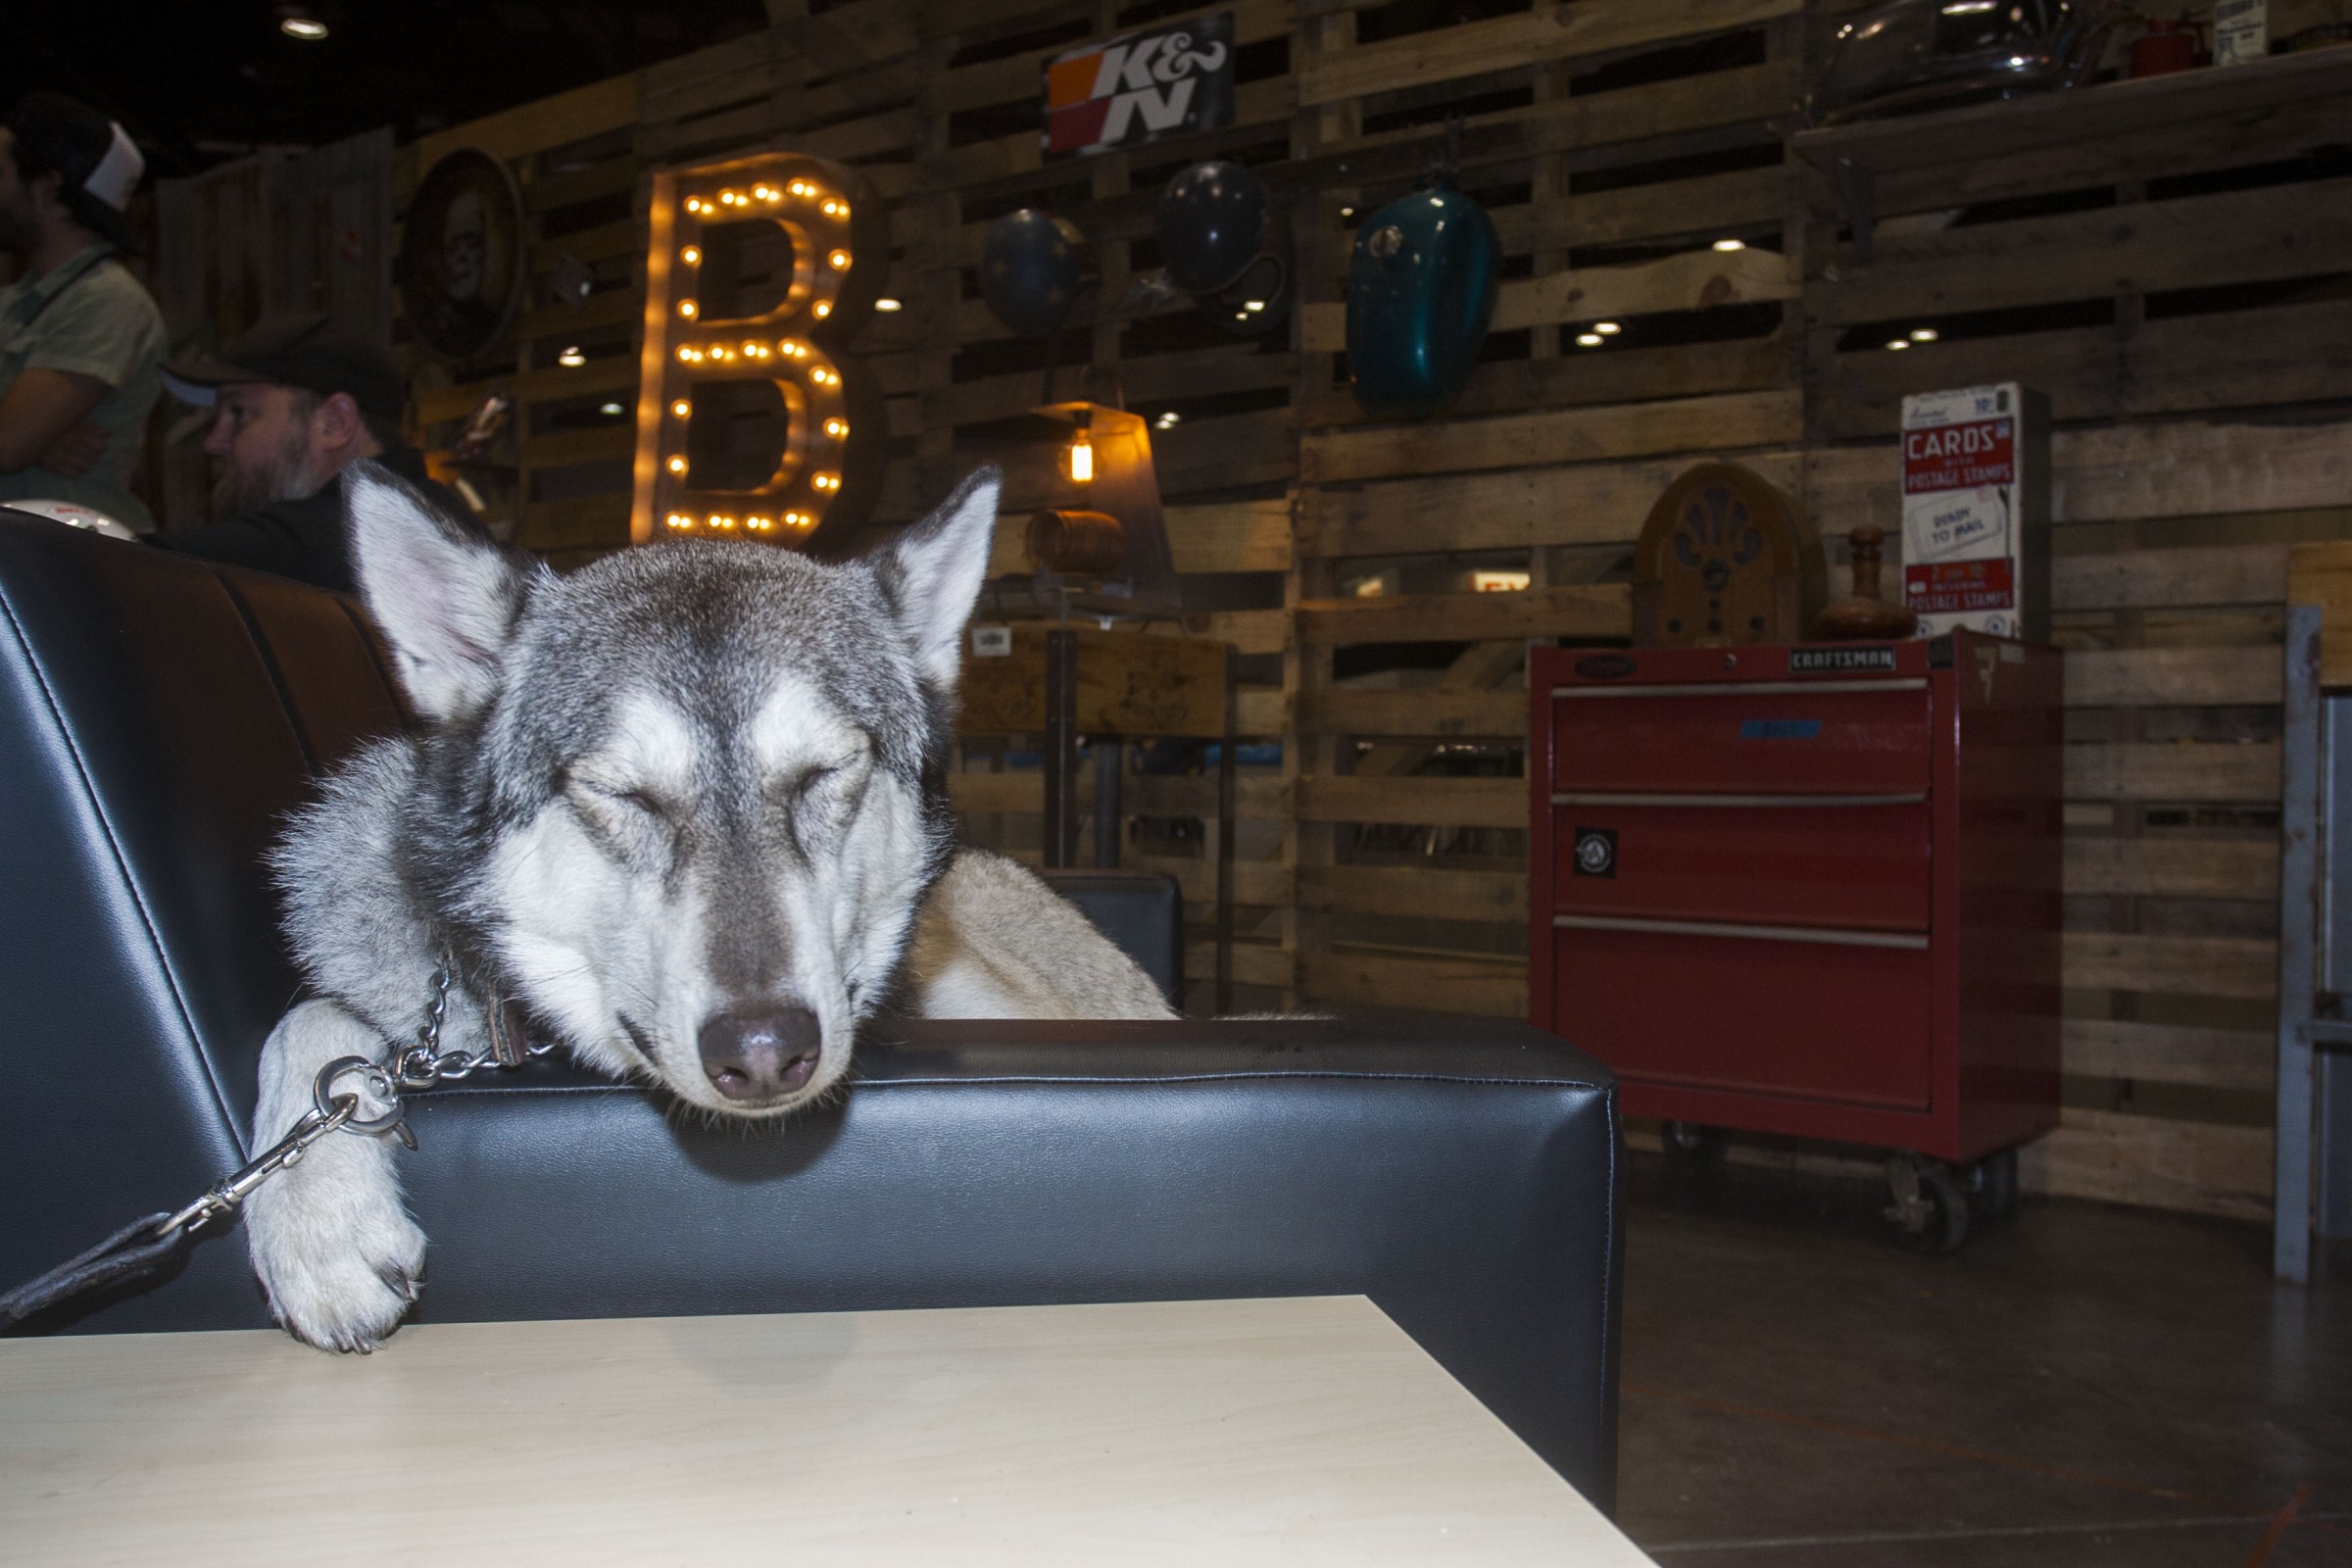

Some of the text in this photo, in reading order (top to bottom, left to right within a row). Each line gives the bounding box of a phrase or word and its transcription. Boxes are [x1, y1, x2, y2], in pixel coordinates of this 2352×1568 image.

[630, 152, 855, 539] B
[1907, 423, 1995, 461] CARDS
[1907, 463, 2011, 490] POSTAGE STAMPS
[1932, 518, 1984, 544] TO MAIL
[1908, 590, 2011, 612] POSTAGE STAMPS
[1791, 650, 1892, 668] CRAFTSMAN
